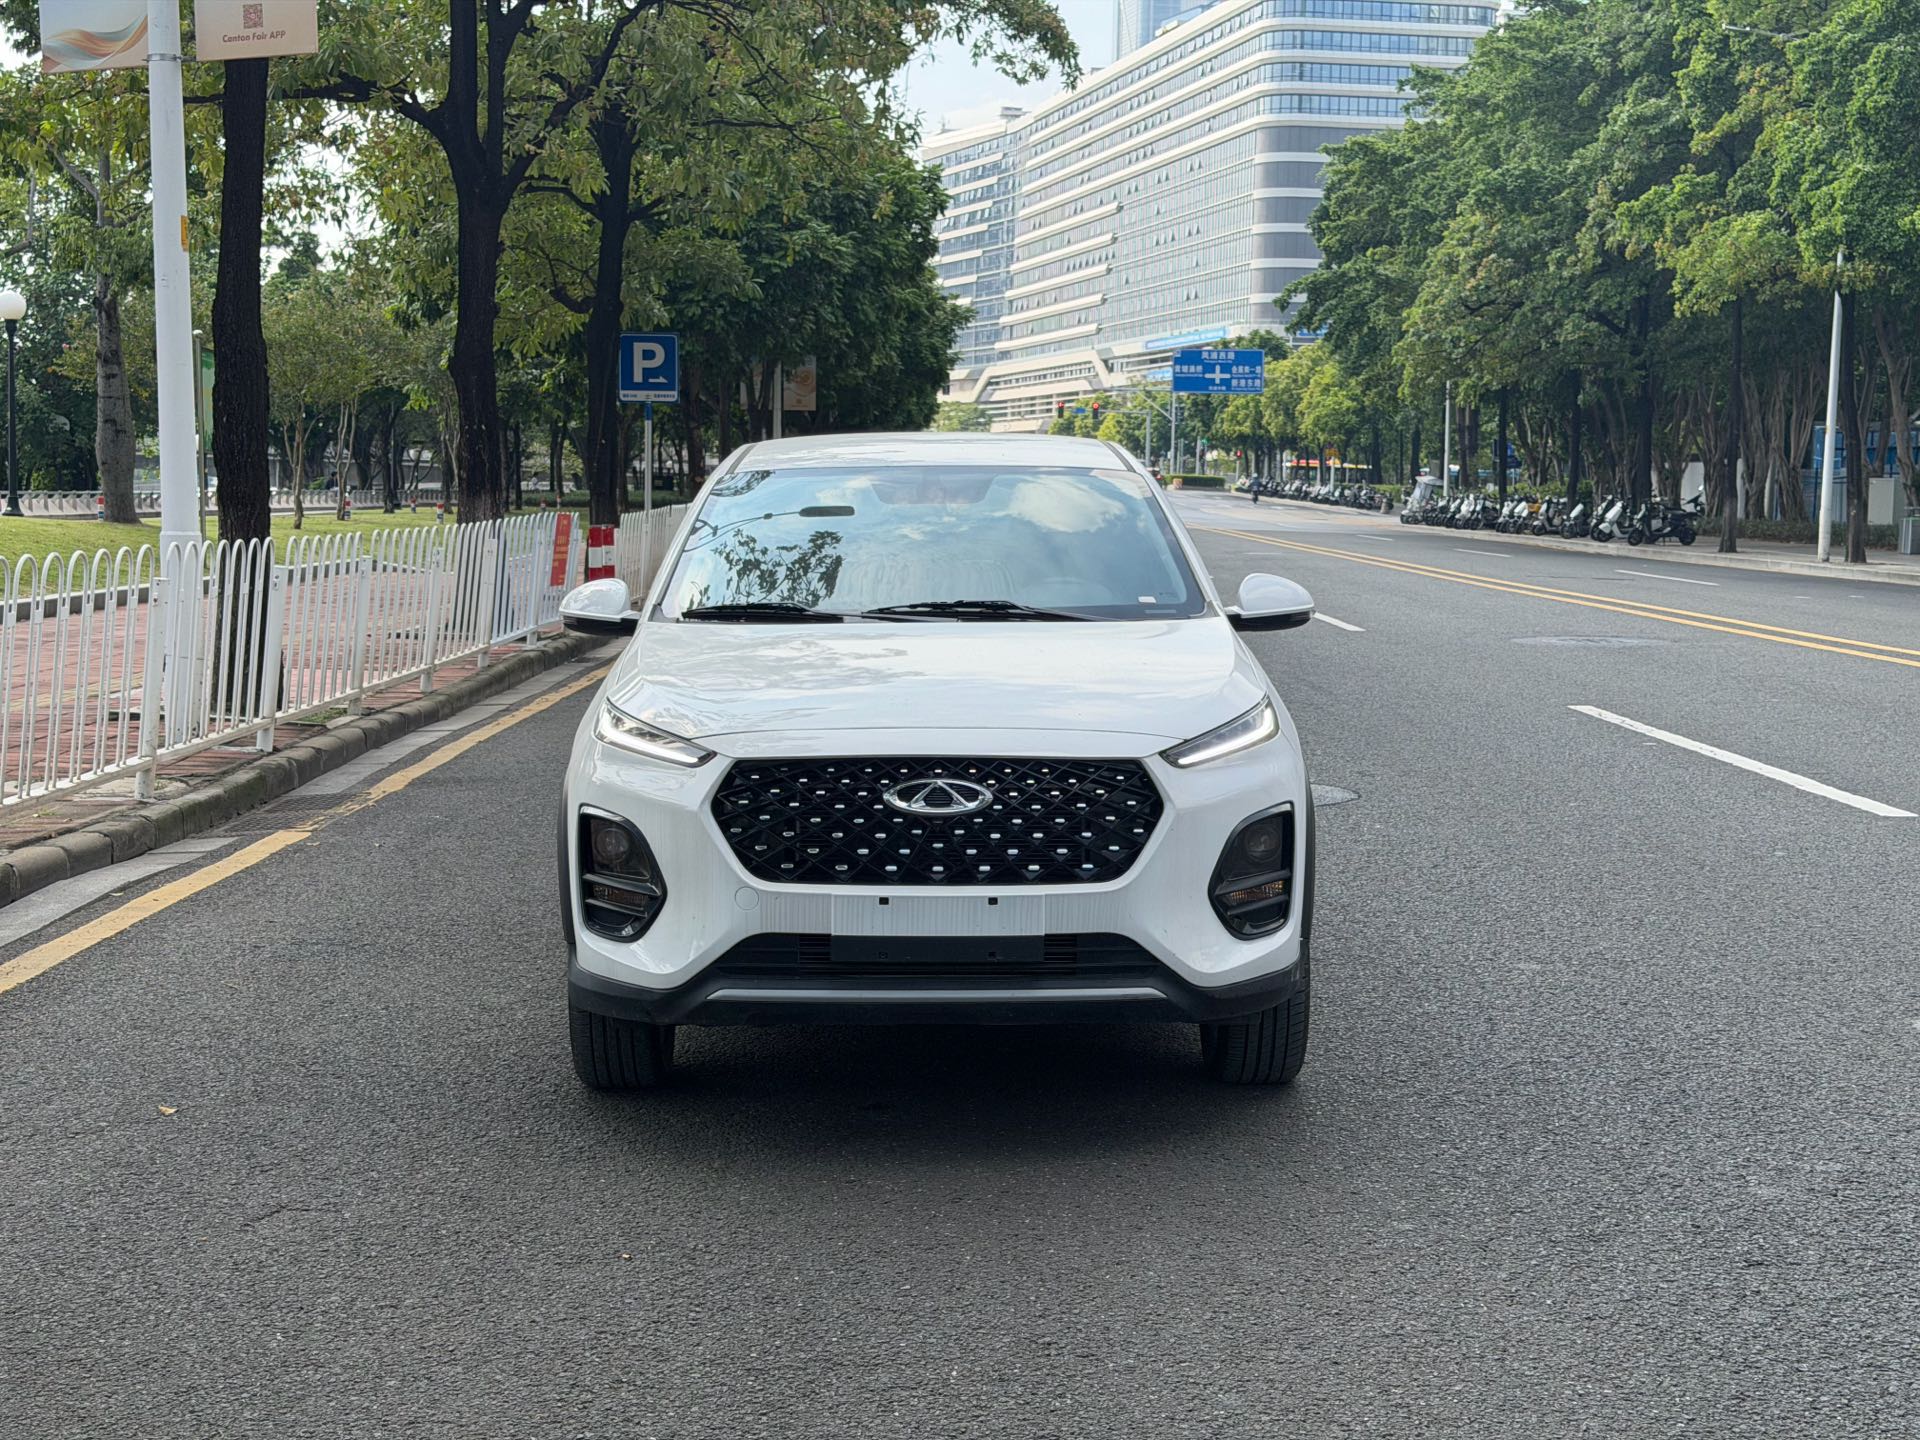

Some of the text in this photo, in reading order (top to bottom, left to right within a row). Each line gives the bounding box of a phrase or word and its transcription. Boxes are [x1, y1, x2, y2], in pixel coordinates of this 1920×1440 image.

[222, 30, 286, 43] Canton Fair APP
[632, 342, 666, 383] P
